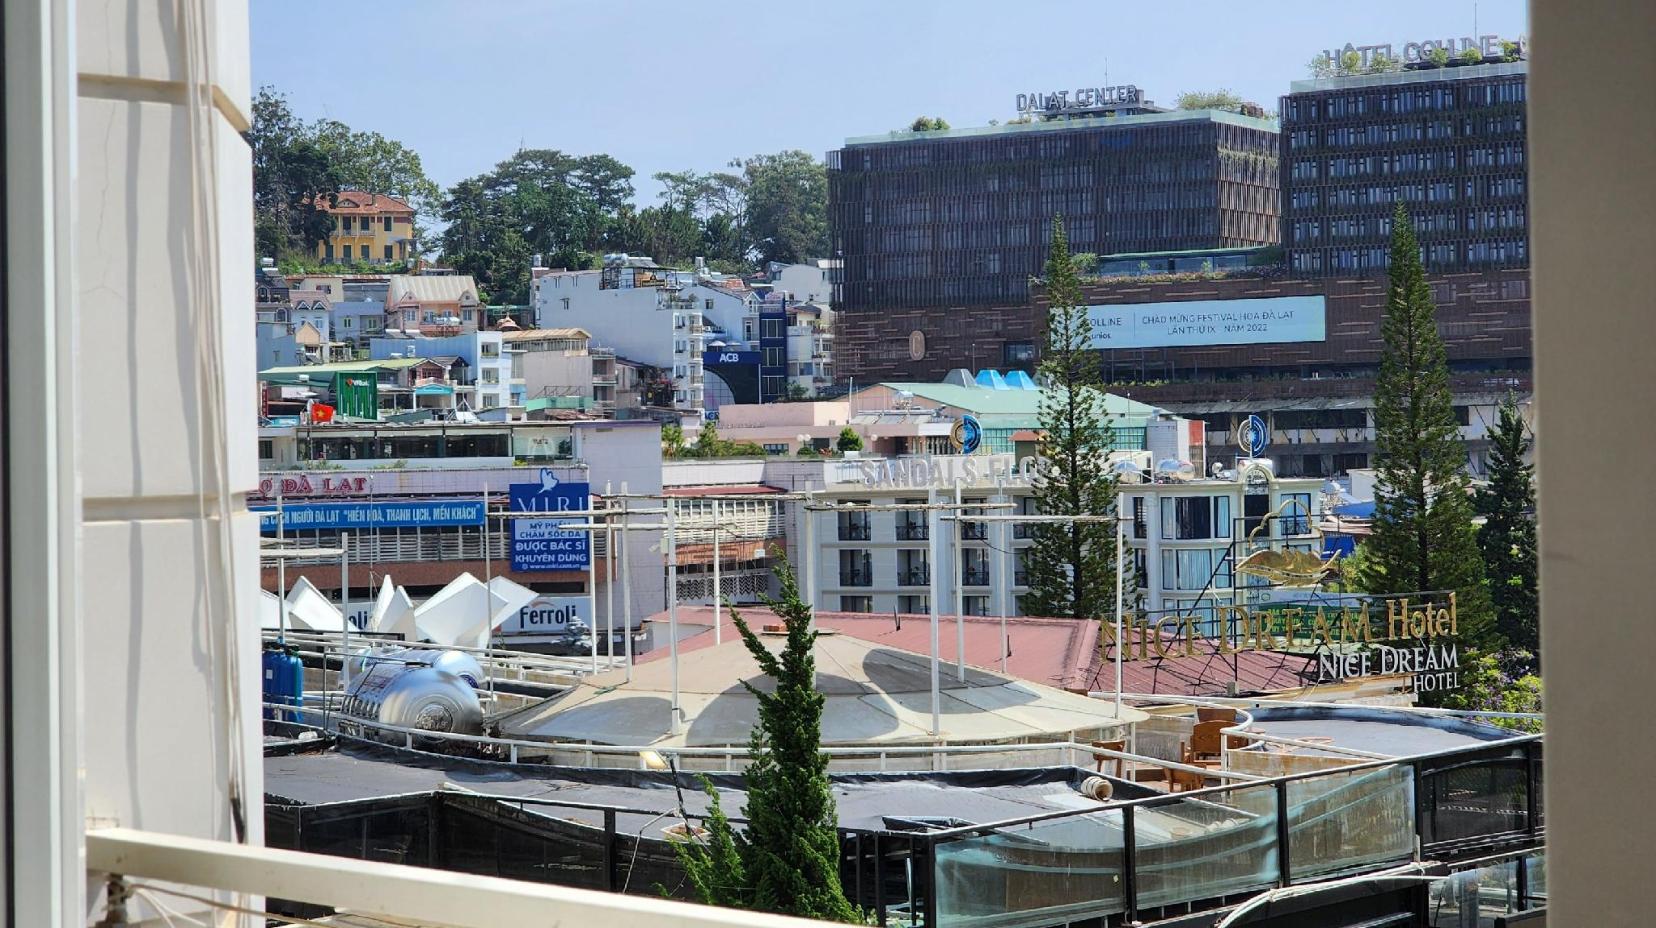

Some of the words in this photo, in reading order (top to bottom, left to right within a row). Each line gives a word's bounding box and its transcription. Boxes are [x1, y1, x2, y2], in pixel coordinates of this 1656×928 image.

[1016, 90, 1069, 111] DALAT
[1075, 84, 1138, 107] CENTER
[1090, 317, 1122, 327] OLLINE
[1198, 312, 1238, 322] FESTIVAL
[1240, 312, 1260, 321] HOA
[1207, 325, 1216, 333] IX
[1247, 323, 1268, 332] 2022
[719, 353, 739, 362] ACB
[861, 455, 977, 488] SANDALS
[281, 474, 314, 494] ĐÀ
[323, 477, 367, 496] LẠT
[516, 496, 584, 512] MIRI
[386, 508, 411, 521] THANH
[515, 541, 547, 553] ĐƯỢC
[550, 540, 572, 550] BÁC
[515, 552, 555, 562] KHUYÊN
[558, 552, 587, 562] DÙNG
[348, 611, 368, 630] oli
[1100, 612, 1204, 664] NICE
[1218, 602, 1373, 654] DREAM
[1386, 591, 1459, 640] Hotel
[1319, 651, 1372, 681] NICE
[1376, 643, 1460, 675] DREAM
[1413, 672, 1461, 693] HOTEL
